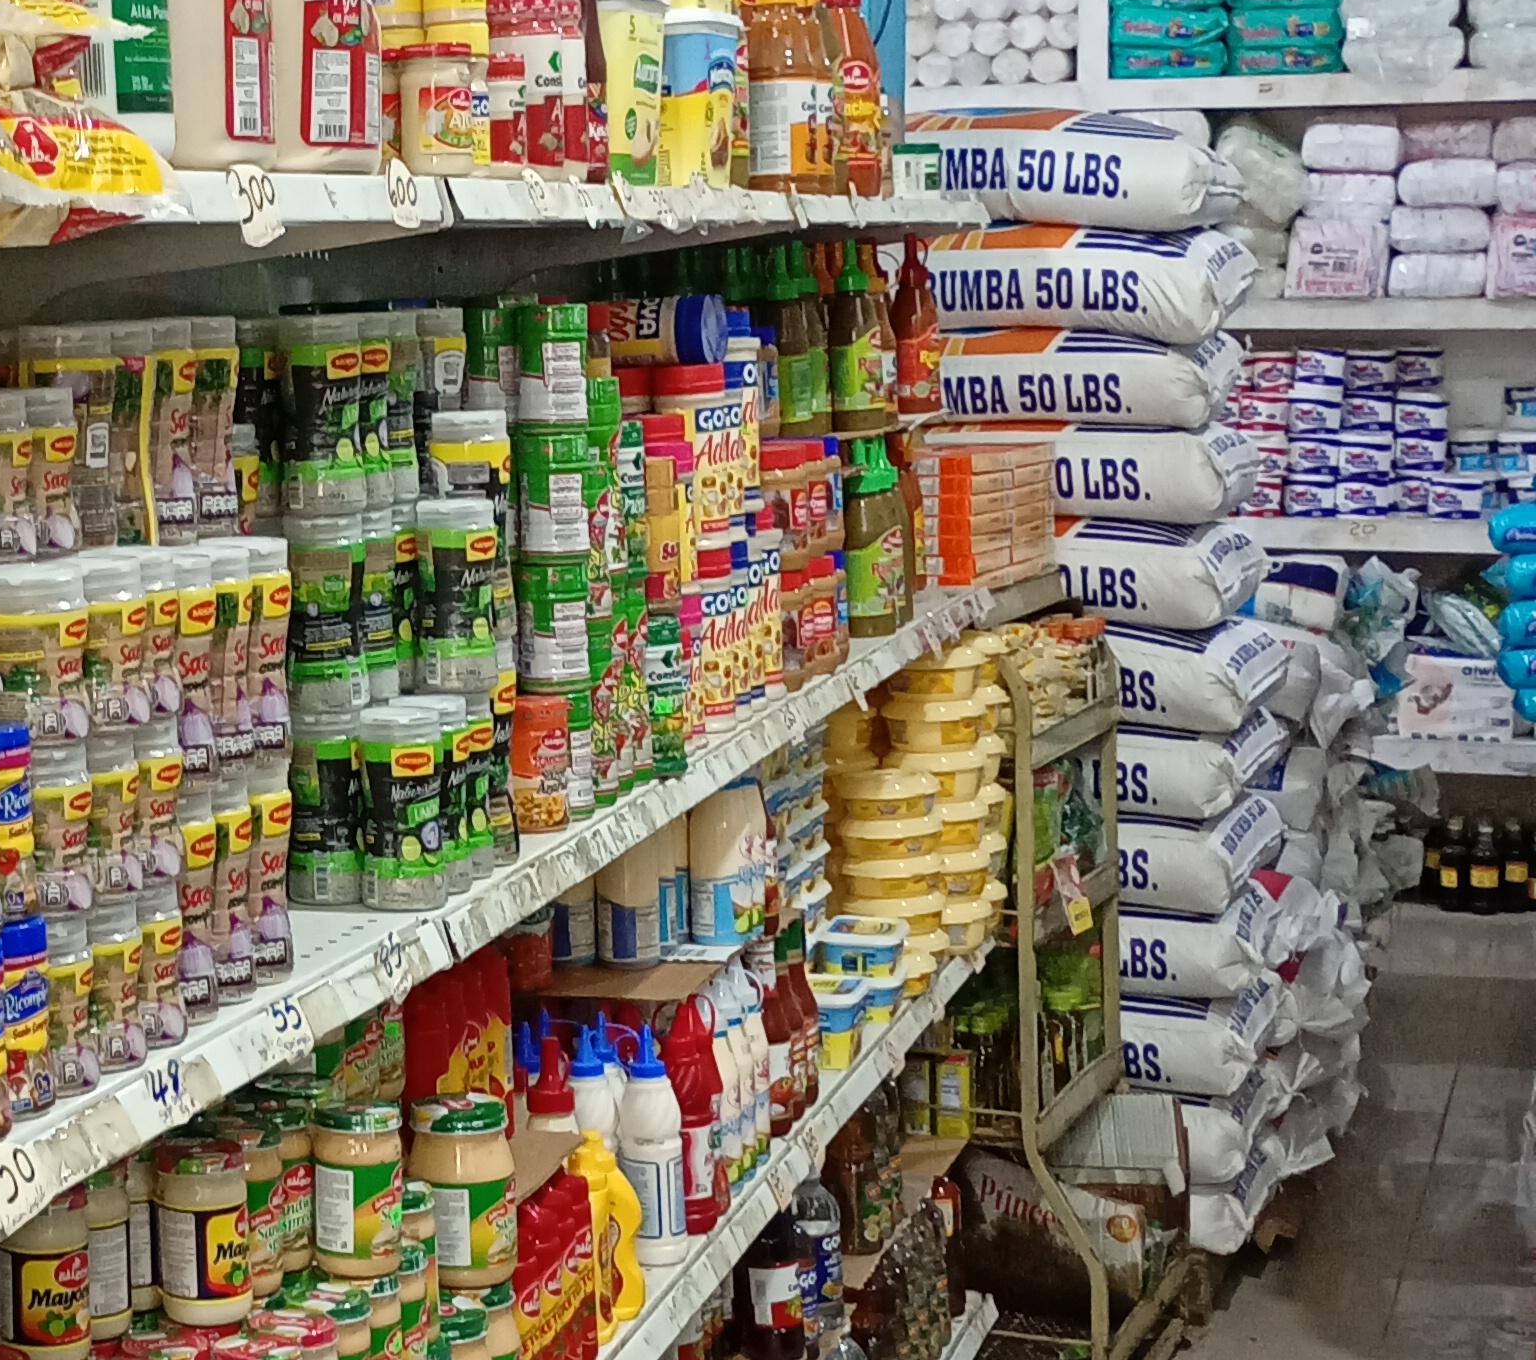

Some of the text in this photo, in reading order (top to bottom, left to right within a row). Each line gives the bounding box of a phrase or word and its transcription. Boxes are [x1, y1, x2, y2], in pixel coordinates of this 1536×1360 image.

[939, 147, 1128, 199] MBA 50 LBS.
[1036, 267, 1073, 311] 50
[1082, 268, 1148, 315] LBS.
[1018, 373, 1057, 414] 50
[1063, 373, 1132, 414] LBS.
[1080, 457, 1151, 501] LBS.
[1080, 565, 1148, 611] LBS.
[270, 994, 302, 1033] 55
